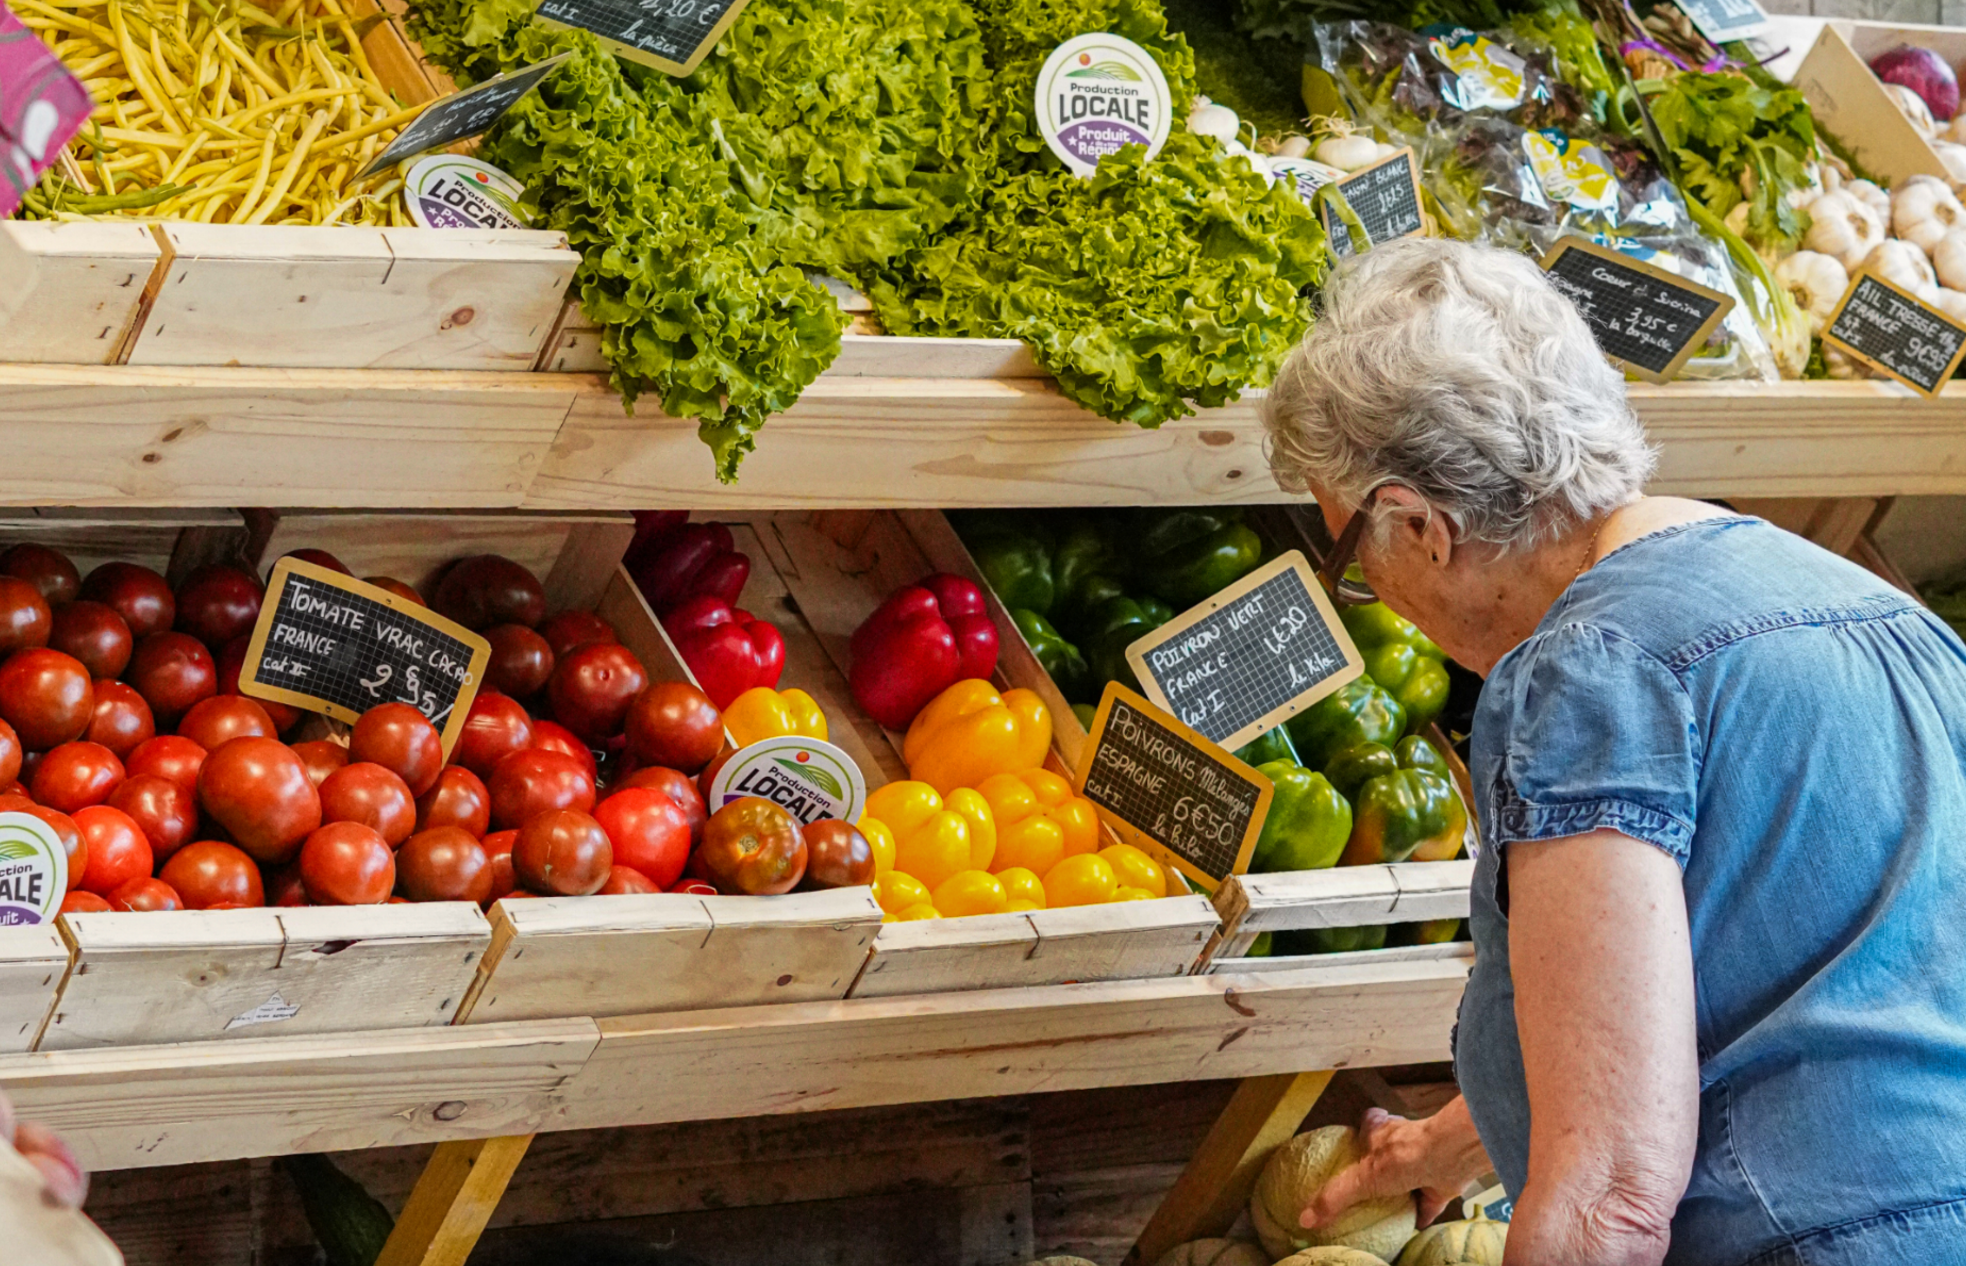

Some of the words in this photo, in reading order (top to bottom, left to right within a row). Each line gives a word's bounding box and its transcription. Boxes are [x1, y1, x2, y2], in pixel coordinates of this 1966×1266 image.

[1071, 83, 1138, 96] Production
[1059, 93, 1149, 131] LOCALE
[1078, 126, 1131, 142] Produit
[428, 178, 508, 229] LOCA
[1858, 281, 1881, 307] AIL
[1848, 300, 1902, 333] FRANCE
[273, 624, 336, 656] FRANCE
[290, 580, 364, 630] TOMATE
[376, 621, 423, 659] VRAC
[428, 650, 473, 686] CACAO
[1152, 624, 1221, 673] POIVRON
[1227, 594, 1263, 630] VERT
[1167, 652, 1227, 699] FRANCE
[1110, 705, 1196, 781] POIVRONS
[768, 766, 831, 809] Production
[1098, 744, 1166, 795] ESPAGNE
[1173, 796, 1235, 846] 6€50
[0, 865, 32, 878] ction
[0, 872, 43, 906] ALE
